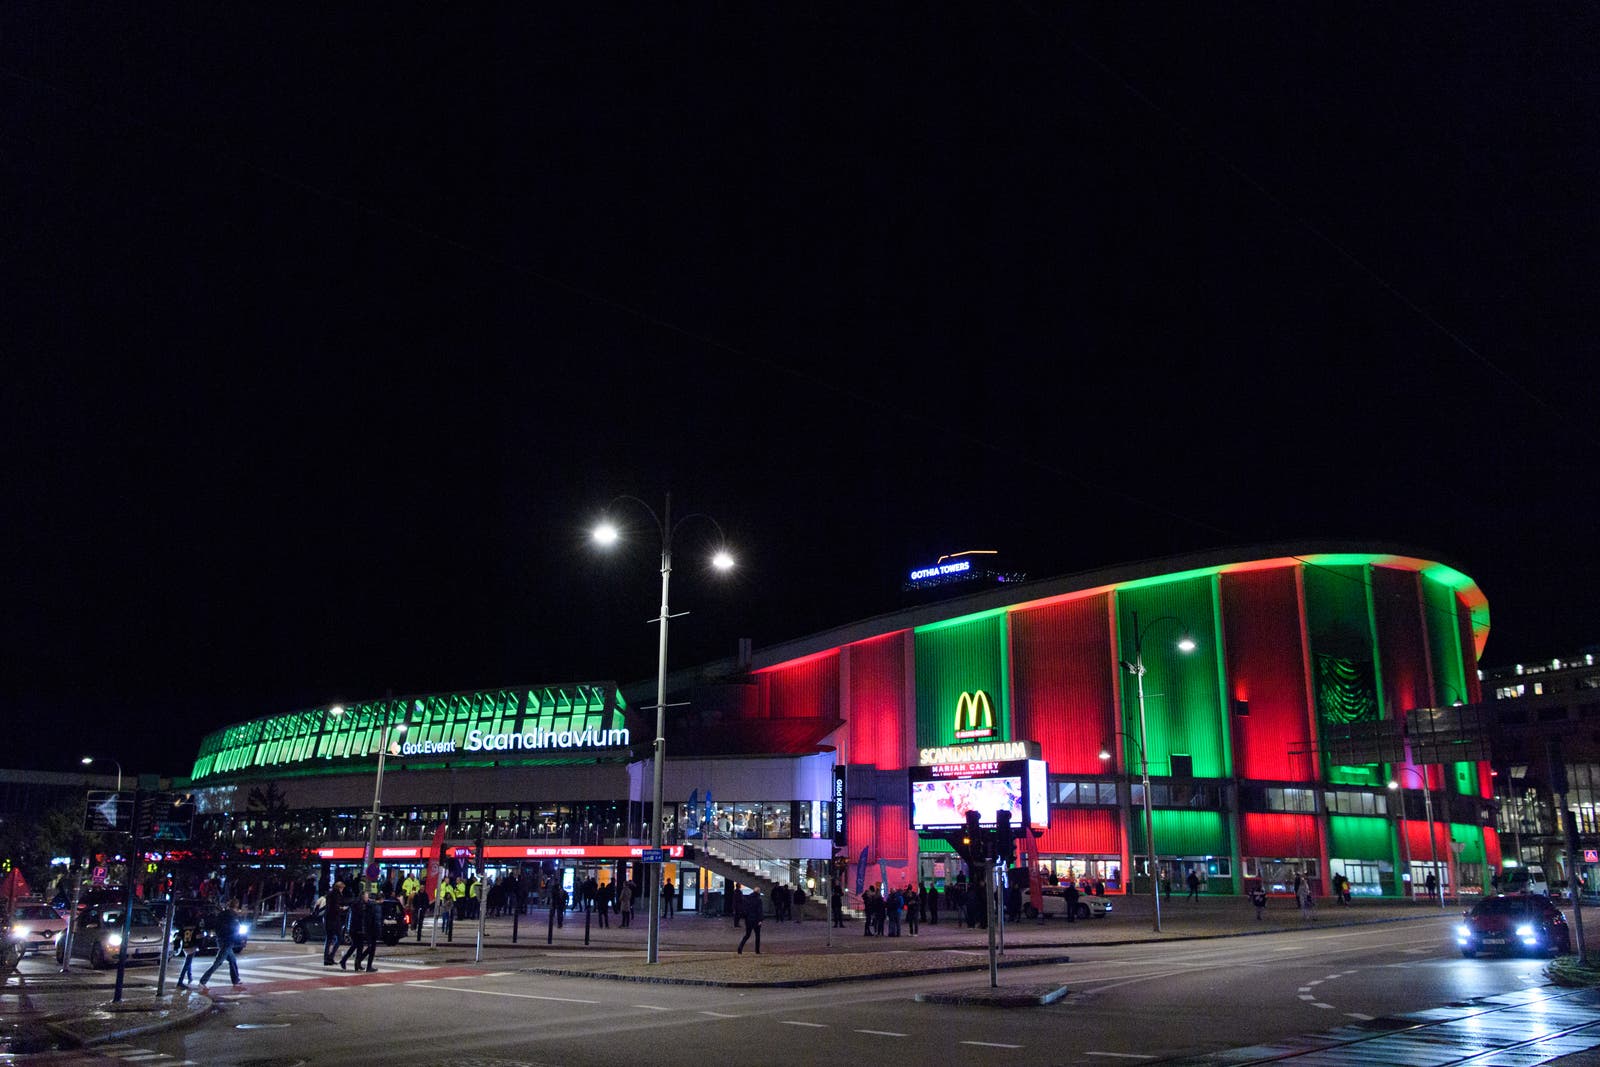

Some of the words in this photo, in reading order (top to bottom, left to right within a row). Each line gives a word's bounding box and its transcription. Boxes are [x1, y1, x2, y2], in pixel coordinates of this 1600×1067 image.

[911, 567, 939, 580] GOTHIA
[940, 561, 970, 574] TOWERS
[402, 742, 423, 755] Got
[424, 740, 456, 754] Event
[468, 725, 630, 752] Scandinavium
[920, 742, 1027, 765] SCANDINAVIUM
[932, 765, 966, 773] MARIAH
[969, 762, 999, 771] CAREY
